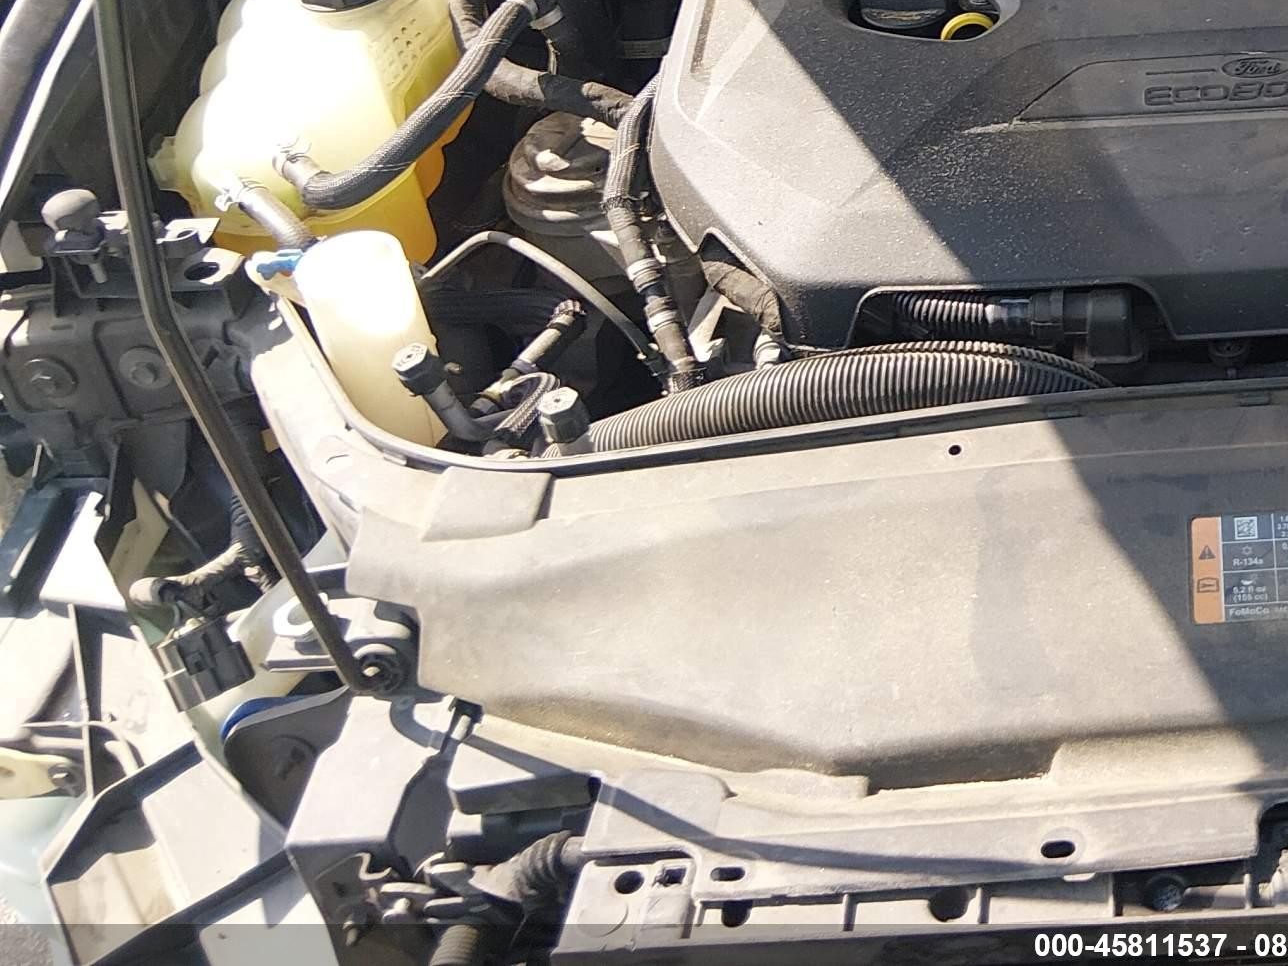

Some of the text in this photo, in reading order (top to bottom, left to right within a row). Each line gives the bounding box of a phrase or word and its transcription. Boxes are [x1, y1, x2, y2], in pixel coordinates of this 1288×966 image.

[1234, 59, 1281, 76] Ford
[1232, 557, 1264, 566] R-134a
[1229, 607, 1270, 617] FoMoCo
